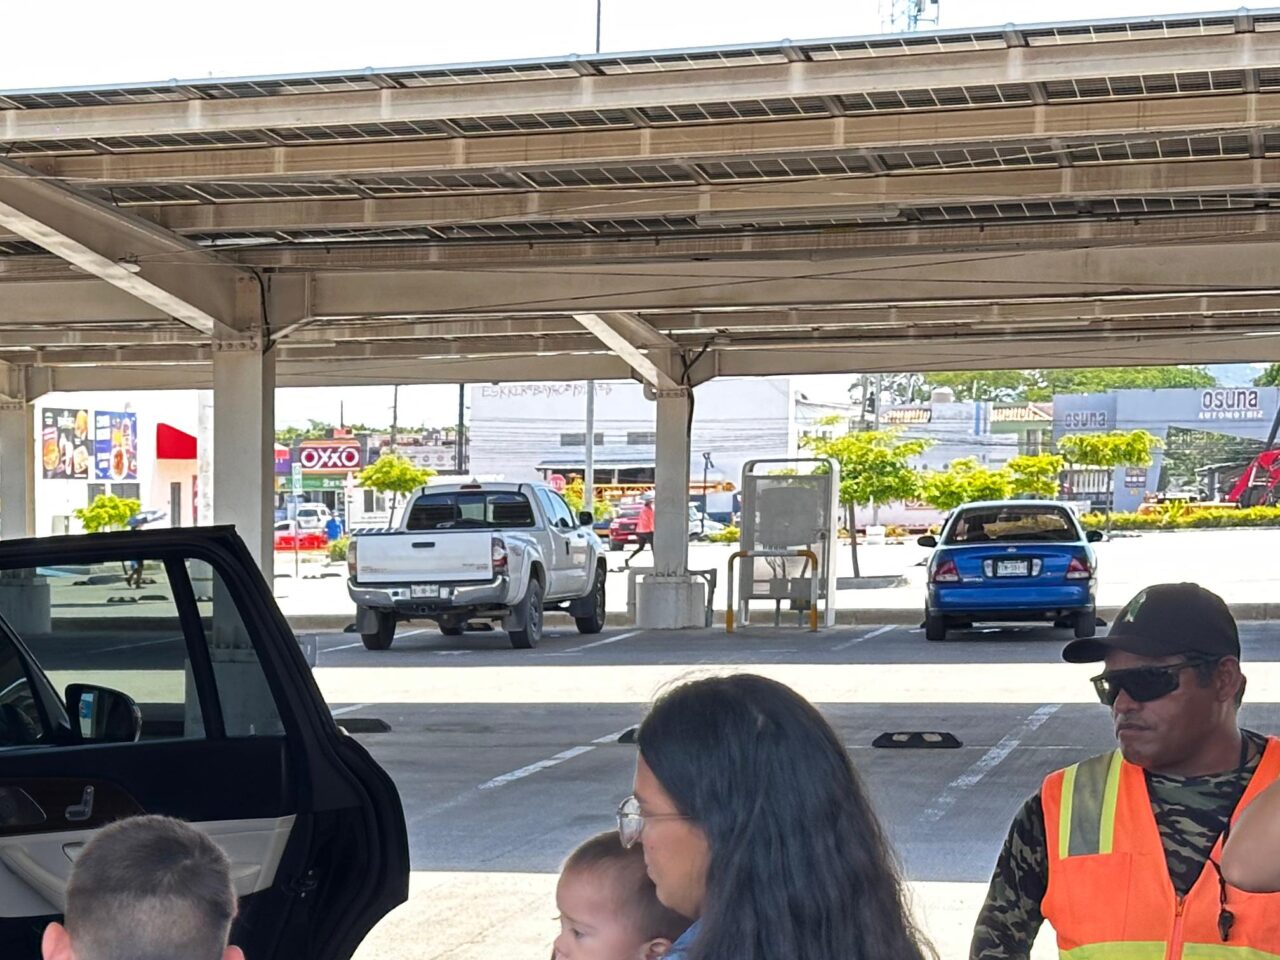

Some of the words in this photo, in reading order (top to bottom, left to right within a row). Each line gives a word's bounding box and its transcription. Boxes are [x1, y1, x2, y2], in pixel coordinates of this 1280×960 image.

[1202, 389, 1259, 409] osuna
[1064, 410, 1107, 429] osuna
[1198, 411, 1265, 420] AUTOMOTRIZ
[301, 446, 360, 469] OXXO
